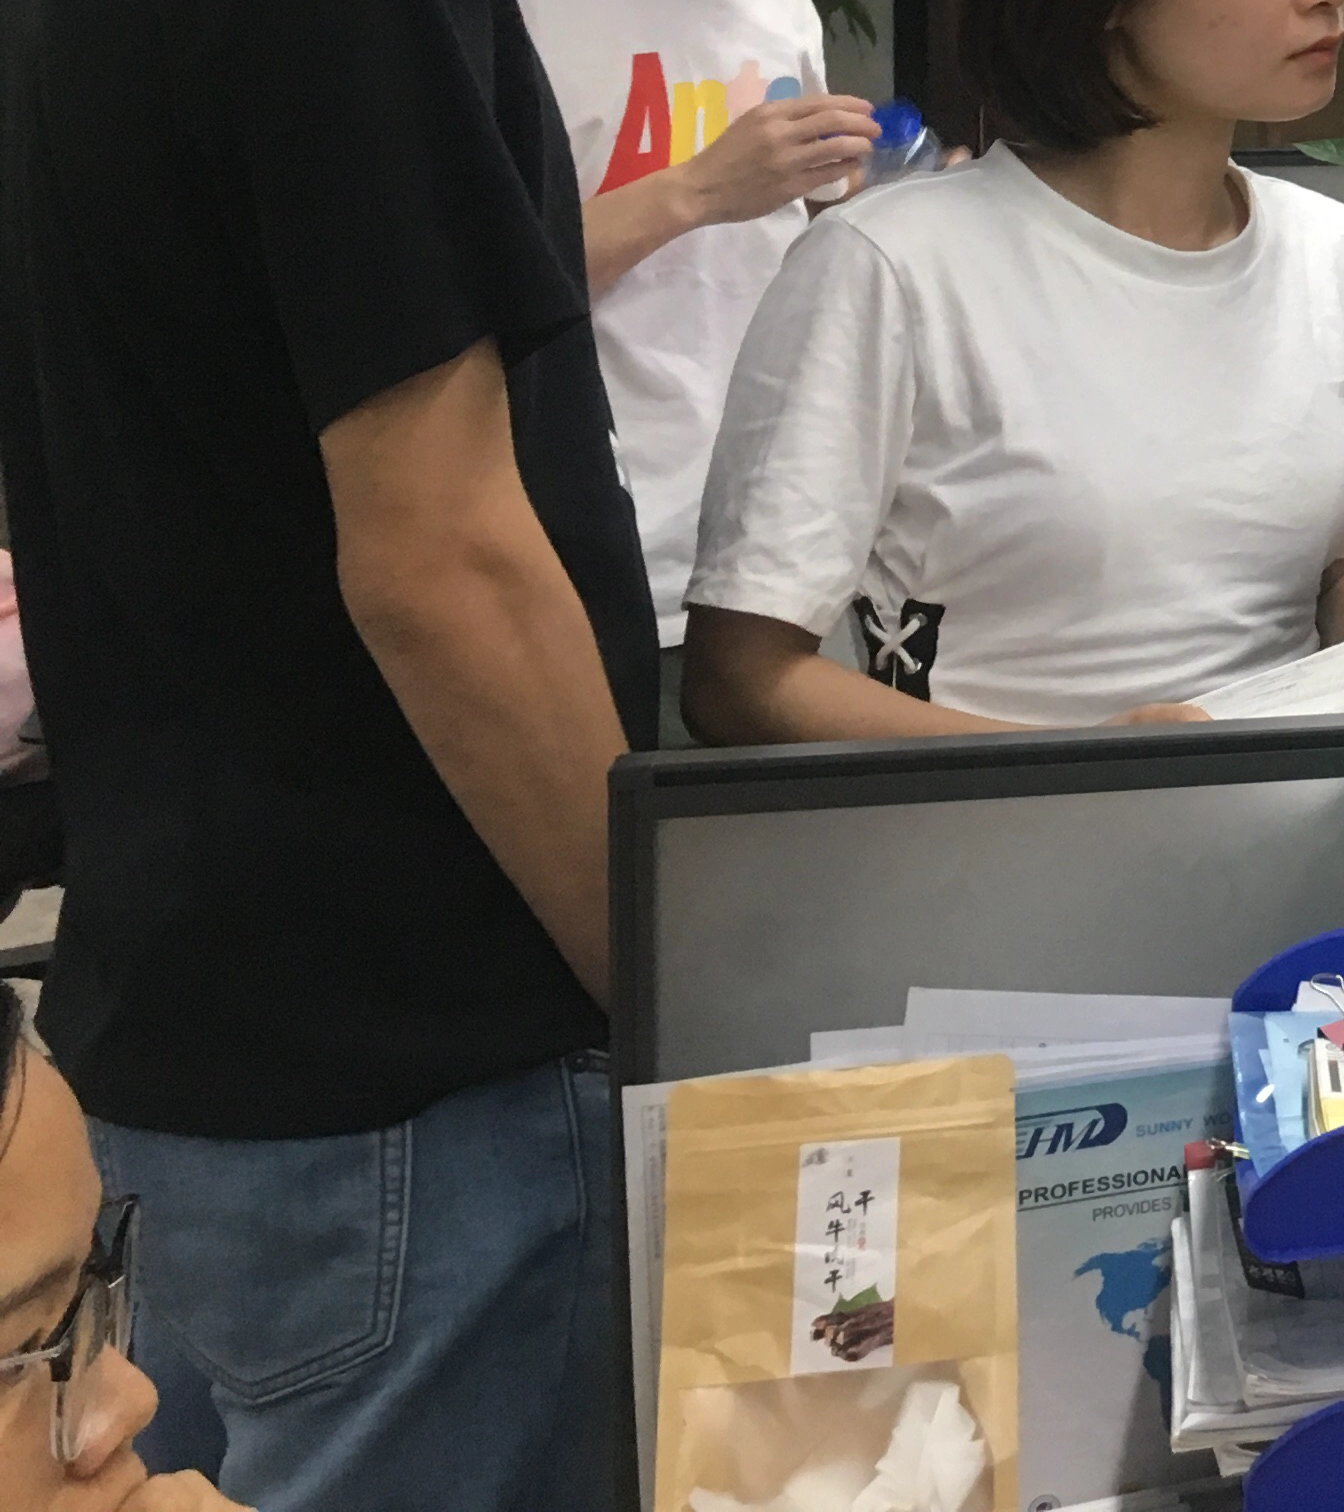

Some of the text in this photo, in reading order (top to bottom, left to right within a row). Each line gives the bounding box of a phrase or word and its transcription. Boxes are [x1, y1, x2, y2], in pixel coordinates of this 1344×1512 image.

[1136, 1113, 1233, 1138] SUNNY WO
[1092, 1197, 1172, 1222] PROVIDES
